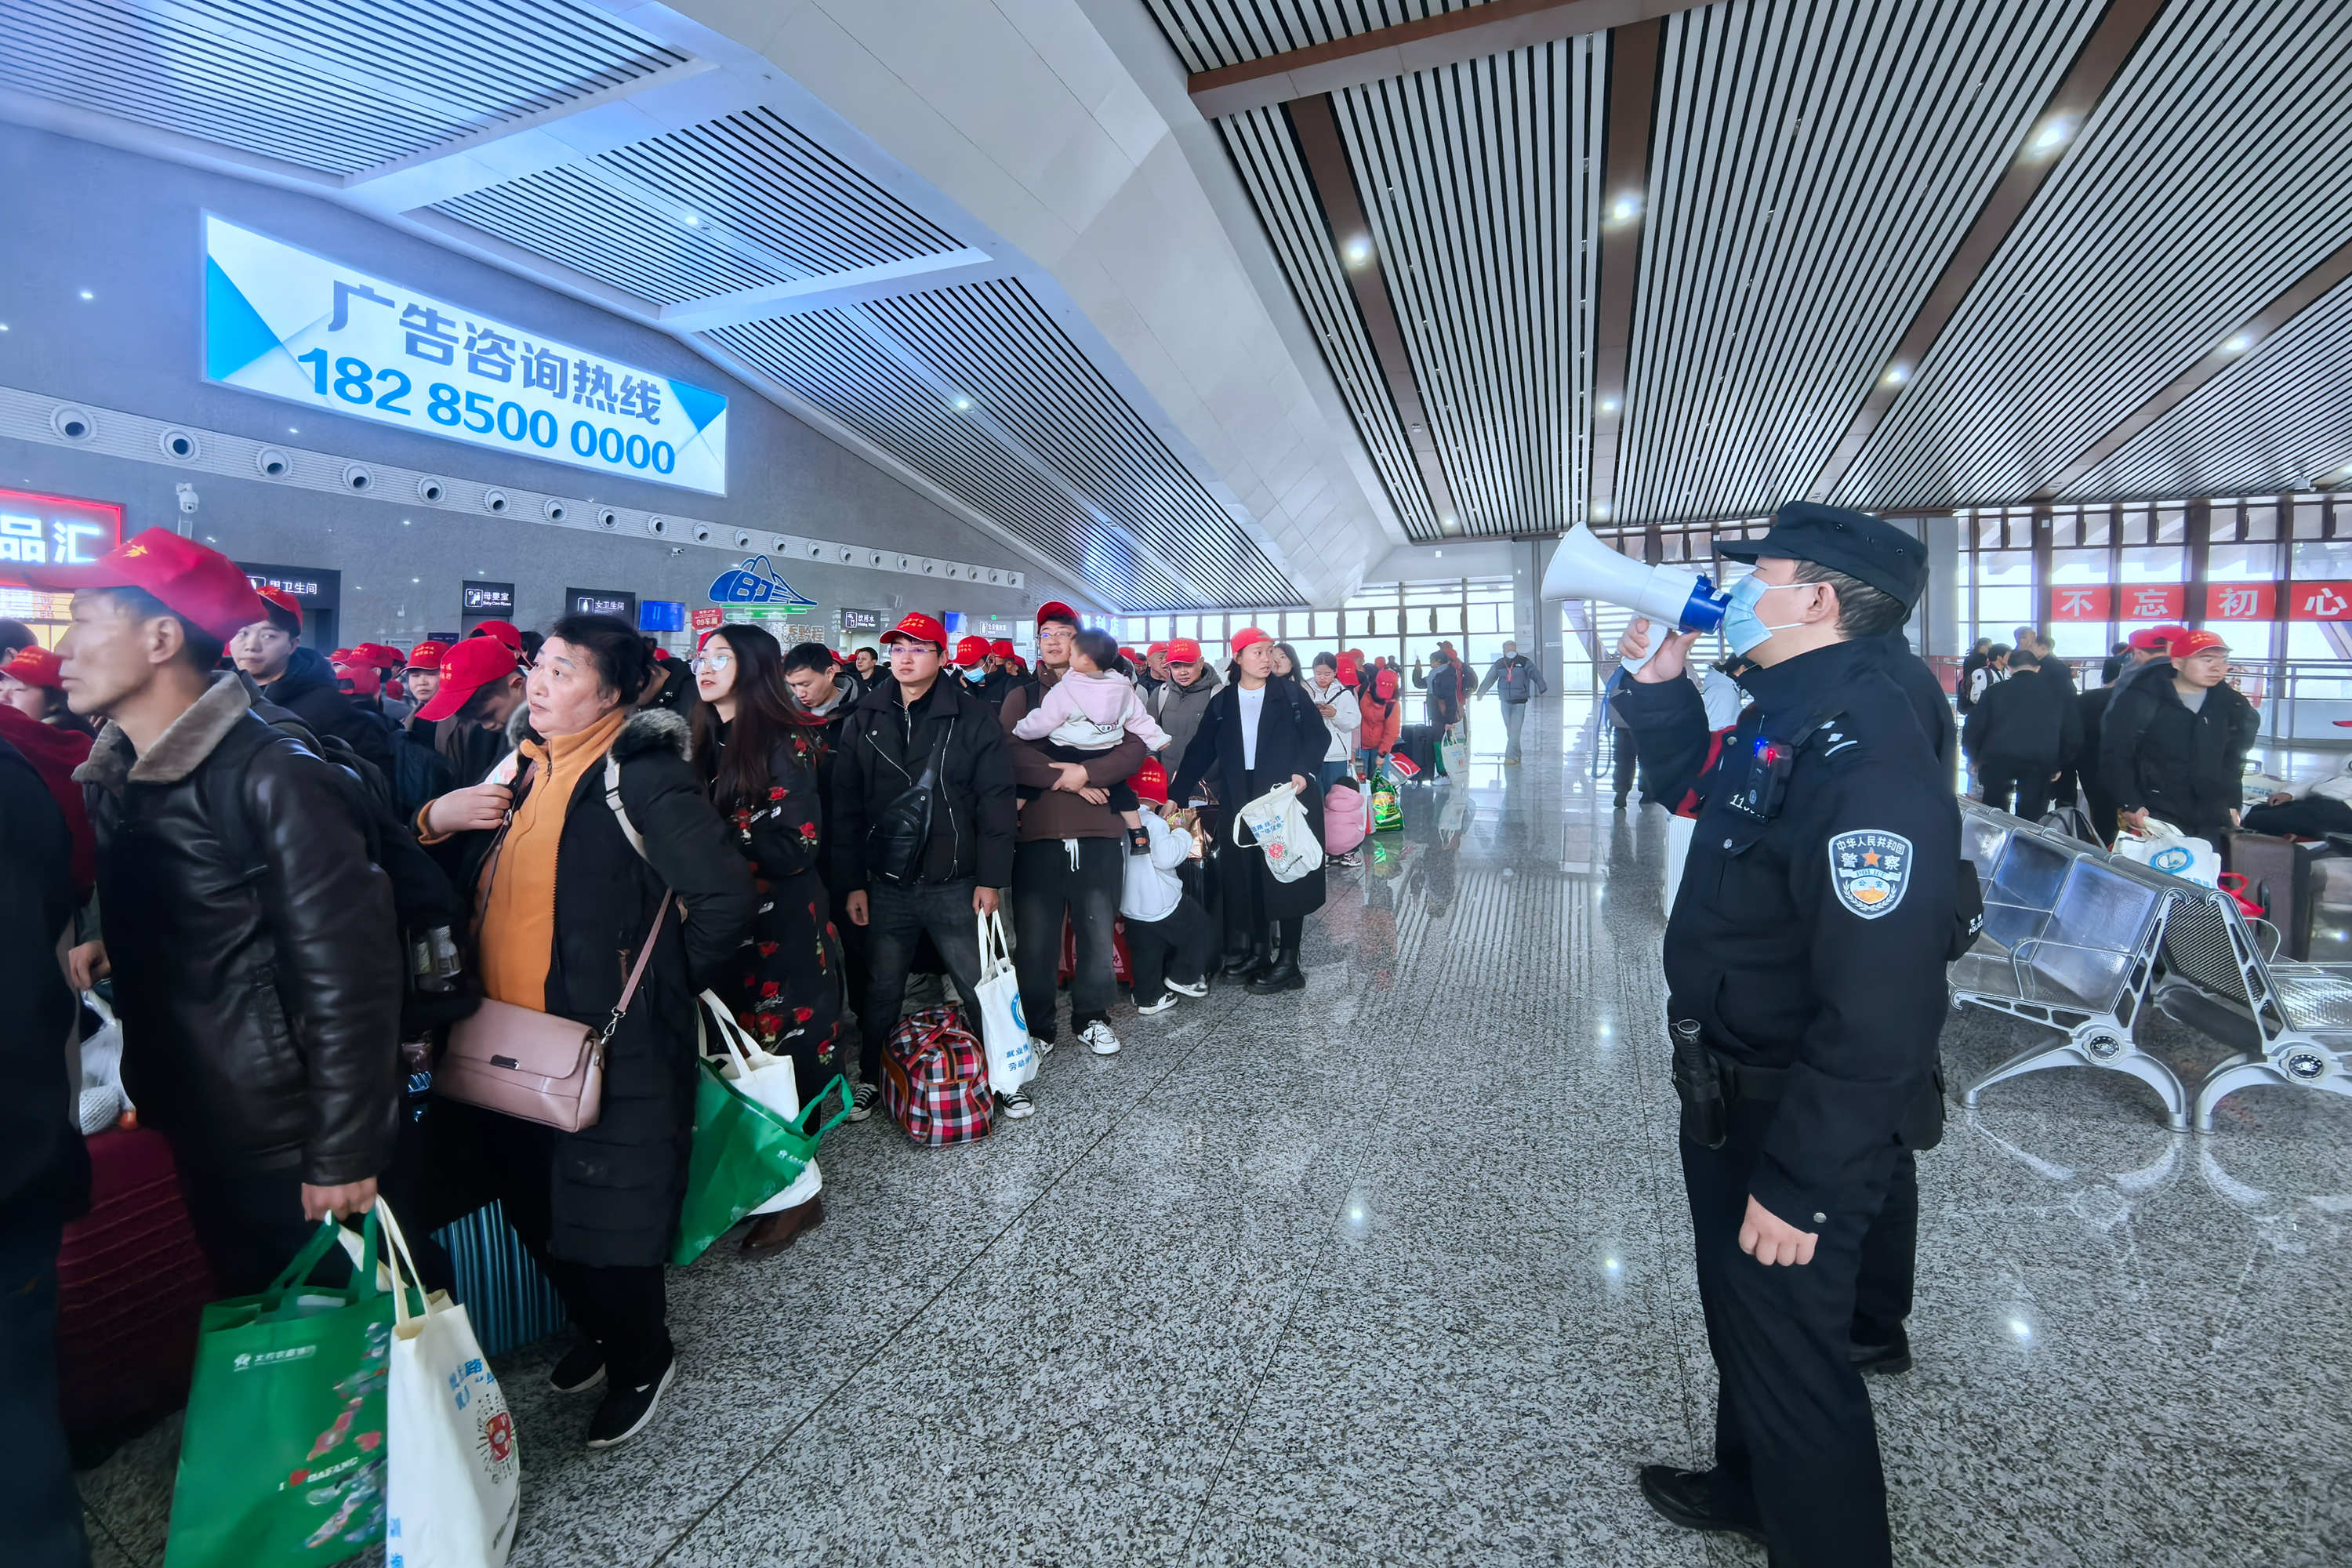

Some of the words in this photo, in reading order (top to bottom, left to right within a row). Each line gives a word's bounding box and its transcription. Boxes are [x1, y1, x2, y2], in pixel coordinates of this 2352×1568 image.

[328, 279, 661, 426] 广告咨询热线
[297, 347, 412, 416] 182
[426, 382, 559, 449] 8500
[570, 419, 676, 475] 0000
[0, 515, 100, 564] 品汇
[483, 591, 510, 602] 母婴室
[595, 600, 625, 611] 女卫生间
[2060, 587, 2348, 618] 不忘初心
[1836, 835, 1906, 856] 中华人民共和国
[1840, 851, 1901, 871] 警察
[1858, 879, 1883, 888] 公安
